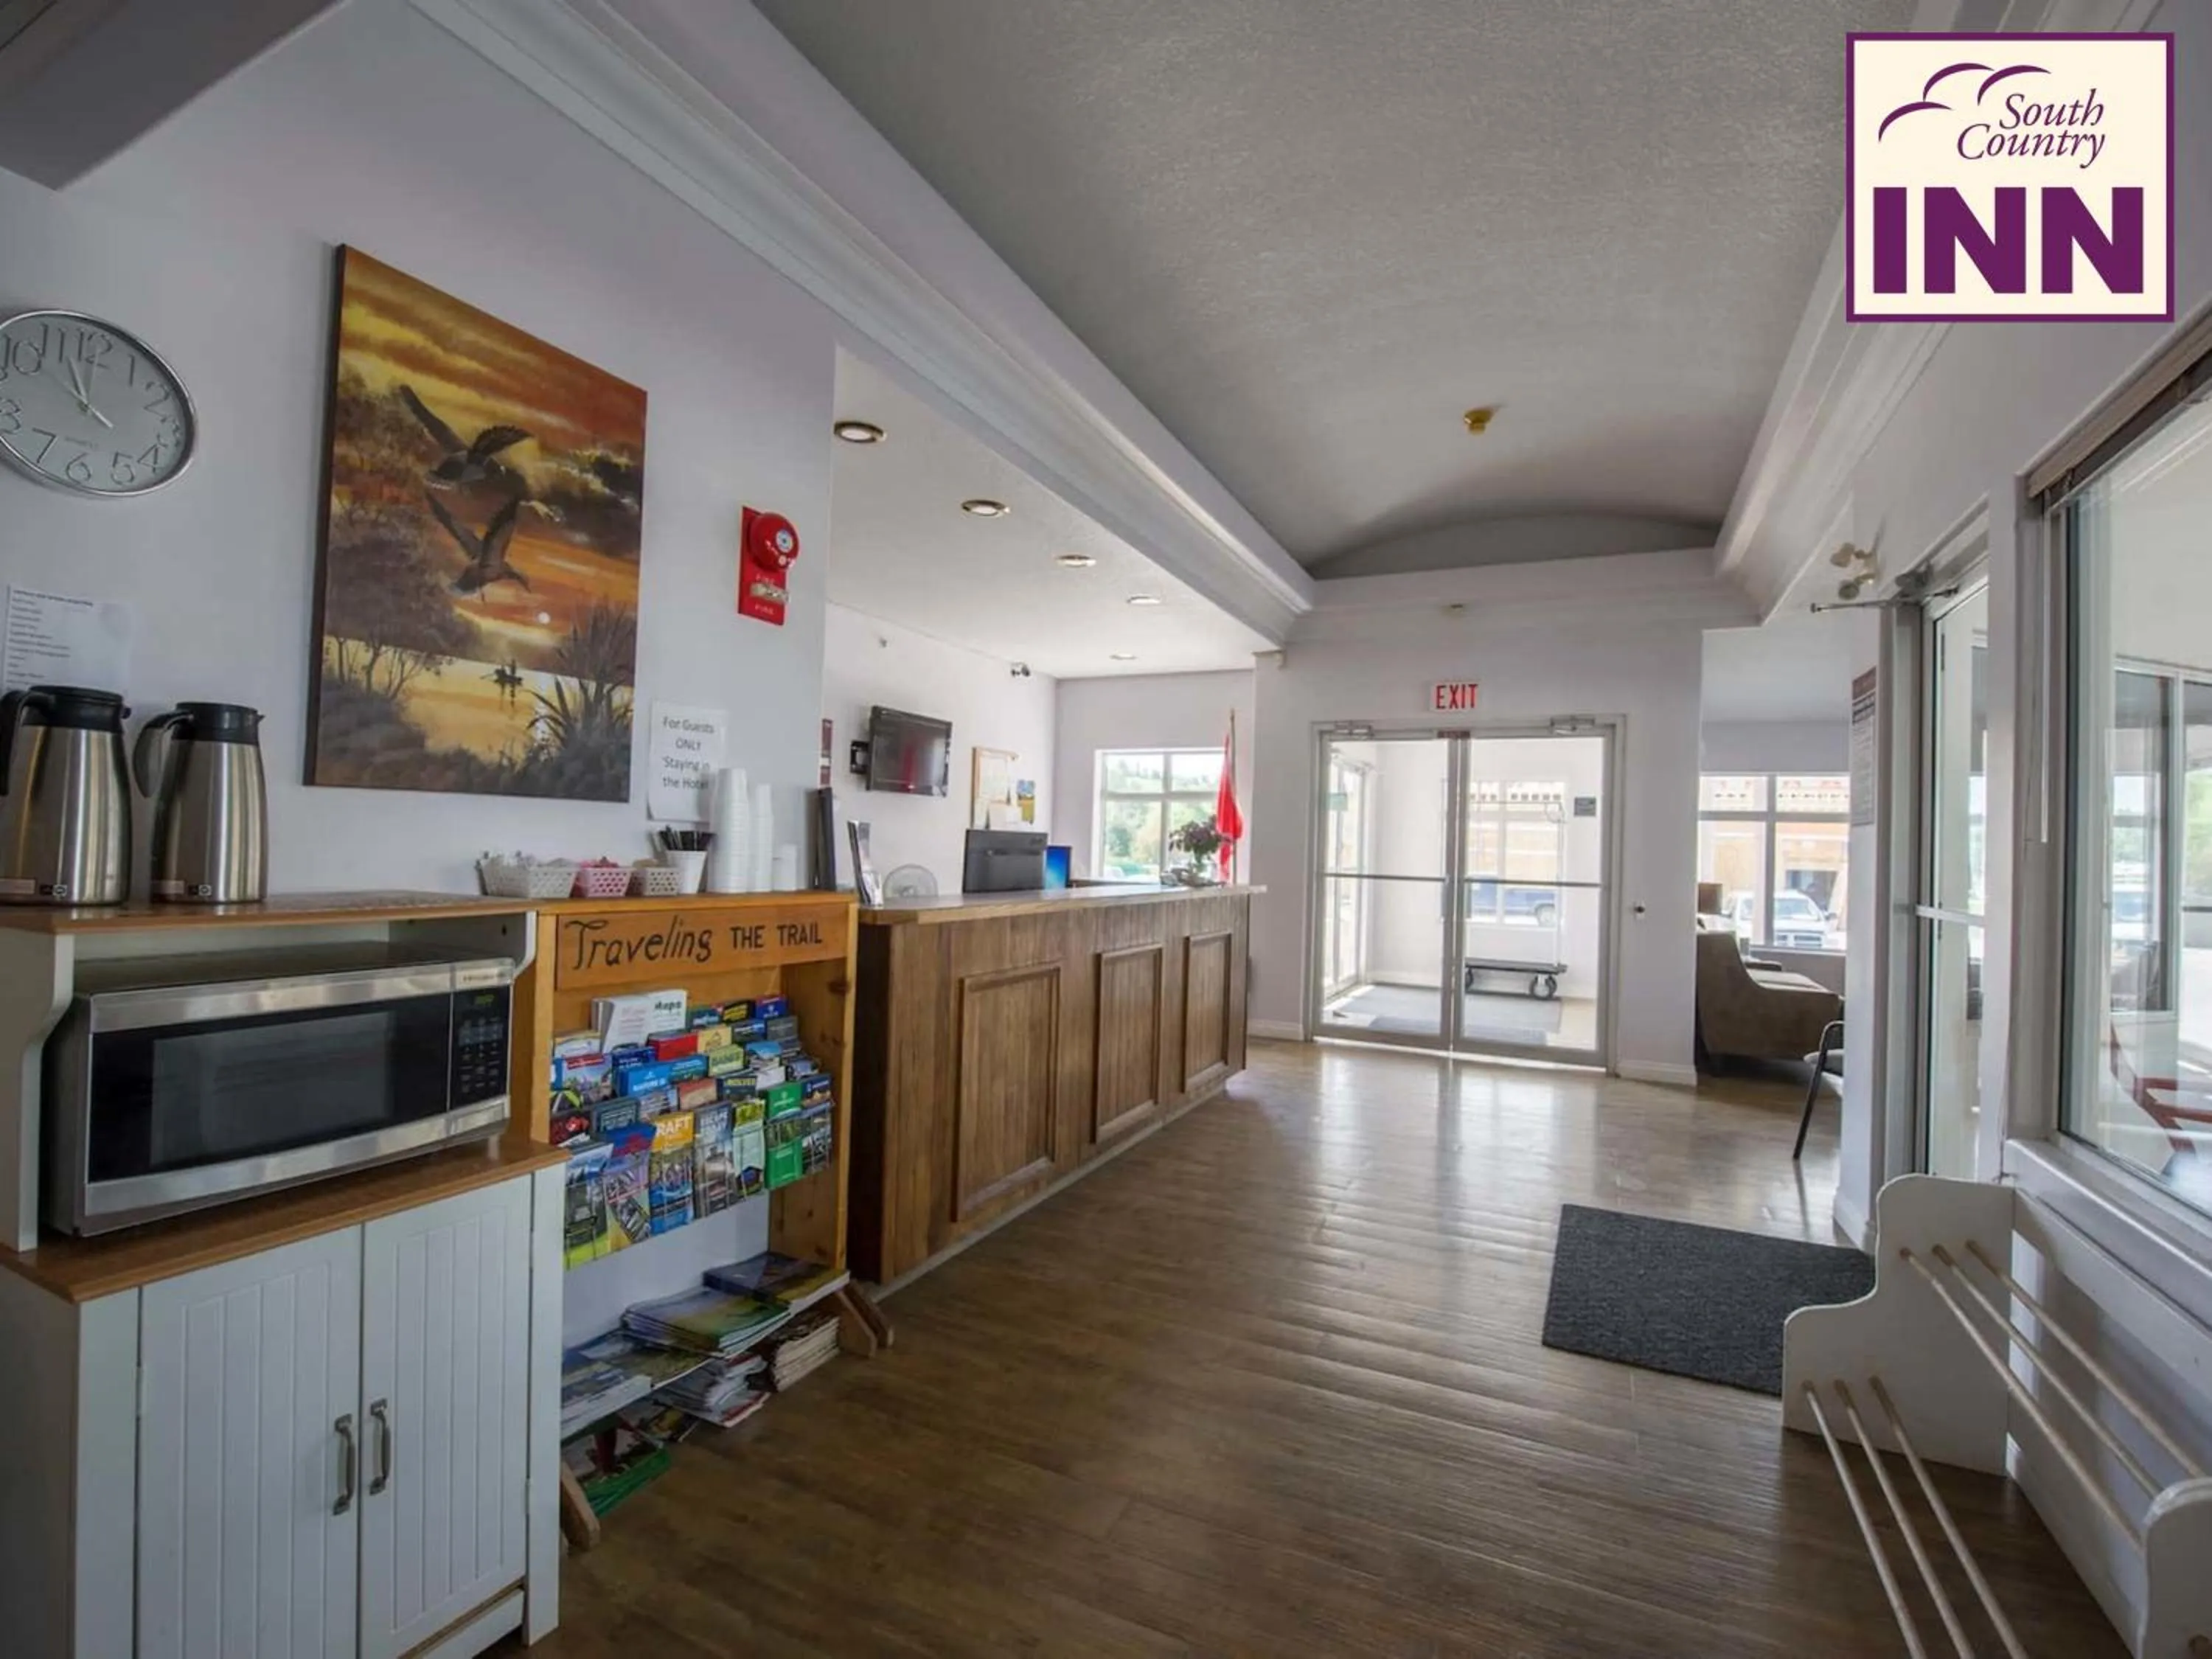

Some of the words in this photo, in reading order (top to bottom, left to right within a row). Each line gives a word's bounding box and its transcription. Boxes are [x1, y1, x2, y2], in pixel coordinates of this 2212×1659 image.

[1436, 683, 1478, 709] EXIT
[675, 737, 701, 751] ONLY
[663, 755, 700, 772] Staying
[663, 776, 680, 789] the
[565, 915, 713, 972] Traveling
[731, 925, 765, 950] THE
[777, 922, 822, 947] TRAIL
